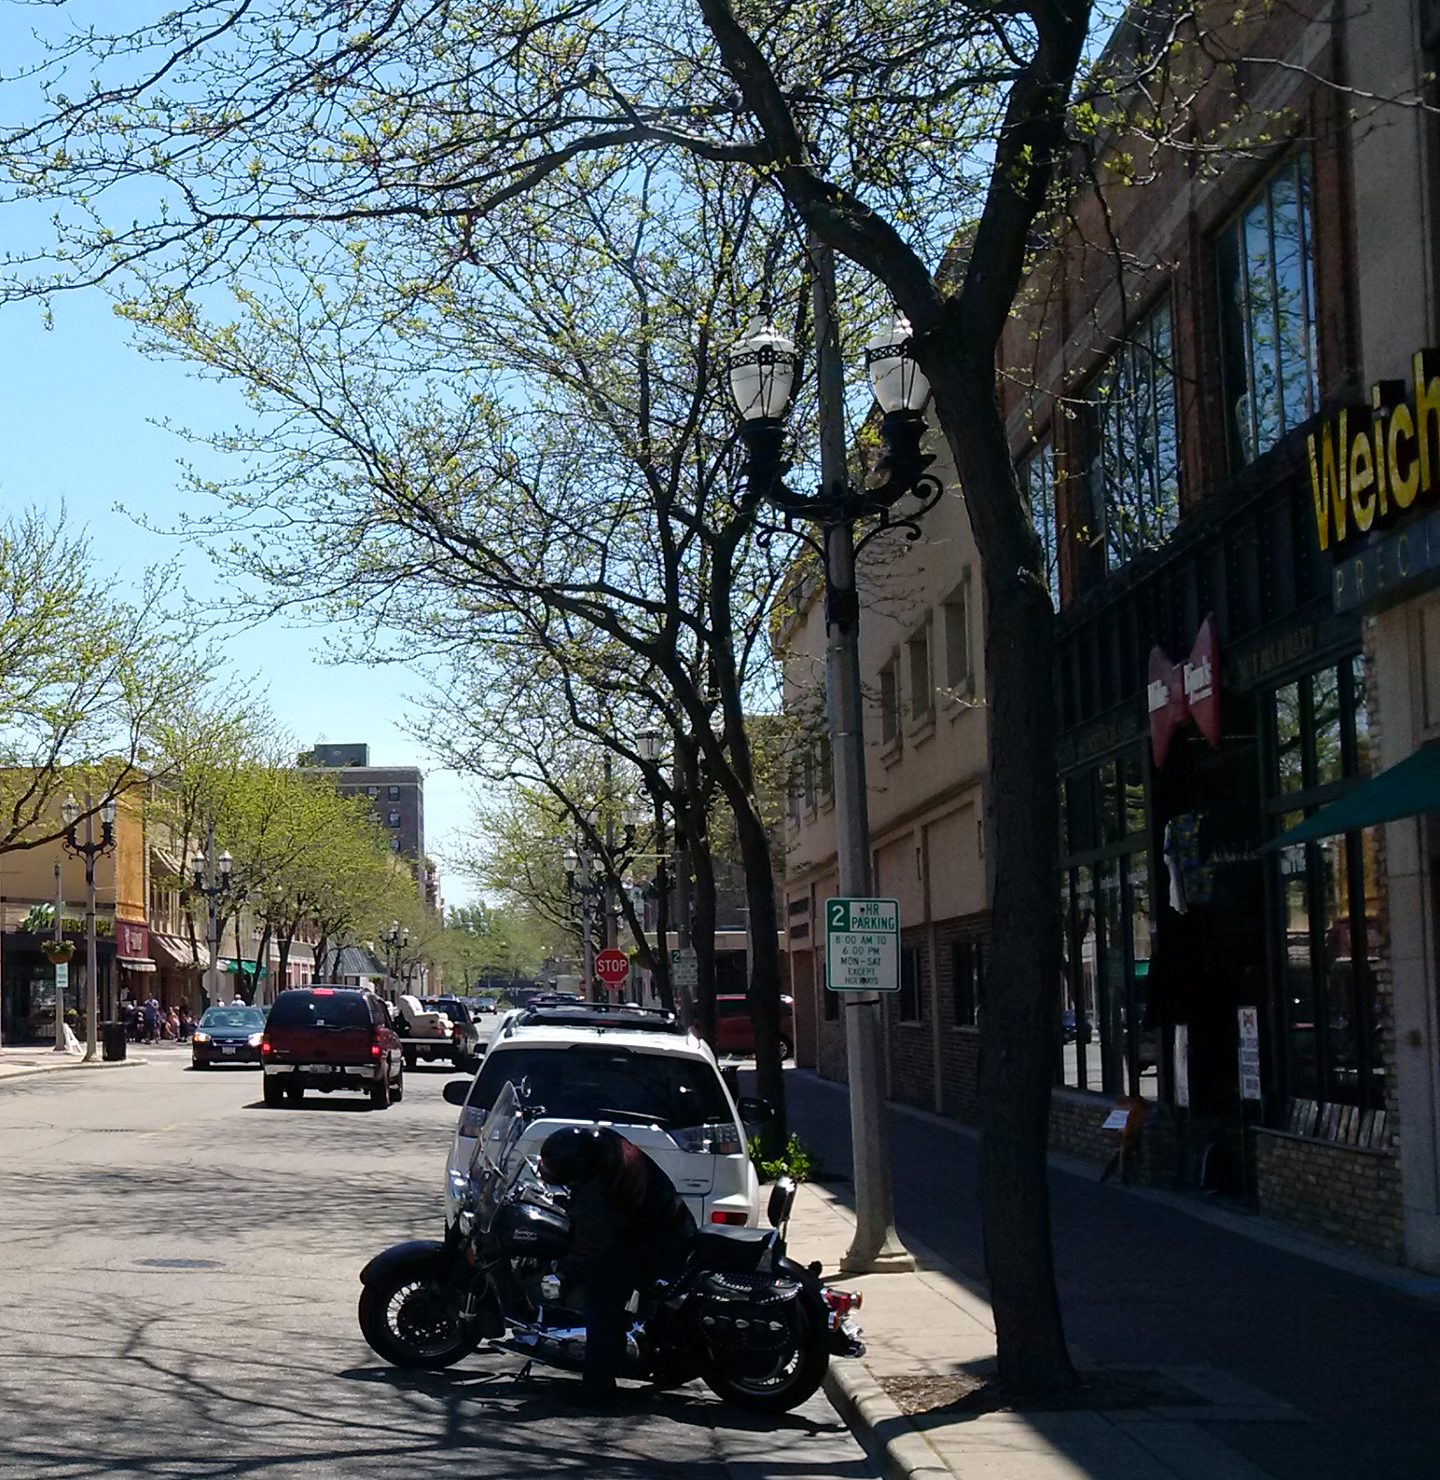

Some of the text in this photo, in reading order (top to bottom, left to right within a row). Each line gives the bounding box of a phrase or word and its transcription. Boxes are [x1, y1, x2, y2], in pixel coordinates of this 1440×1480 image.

[832, 905, 845, 926] 2
[866, 903, 880, 916] HR
[851, 917, 895, 930] PARKING
[861, 936, 873, 945] AM
[673, 951, 680, 962] 2
[868, 947, 880, 955] PM
[597, 959, 628, 972] STOP
[848, 967, 876, 976] EXCEPT
